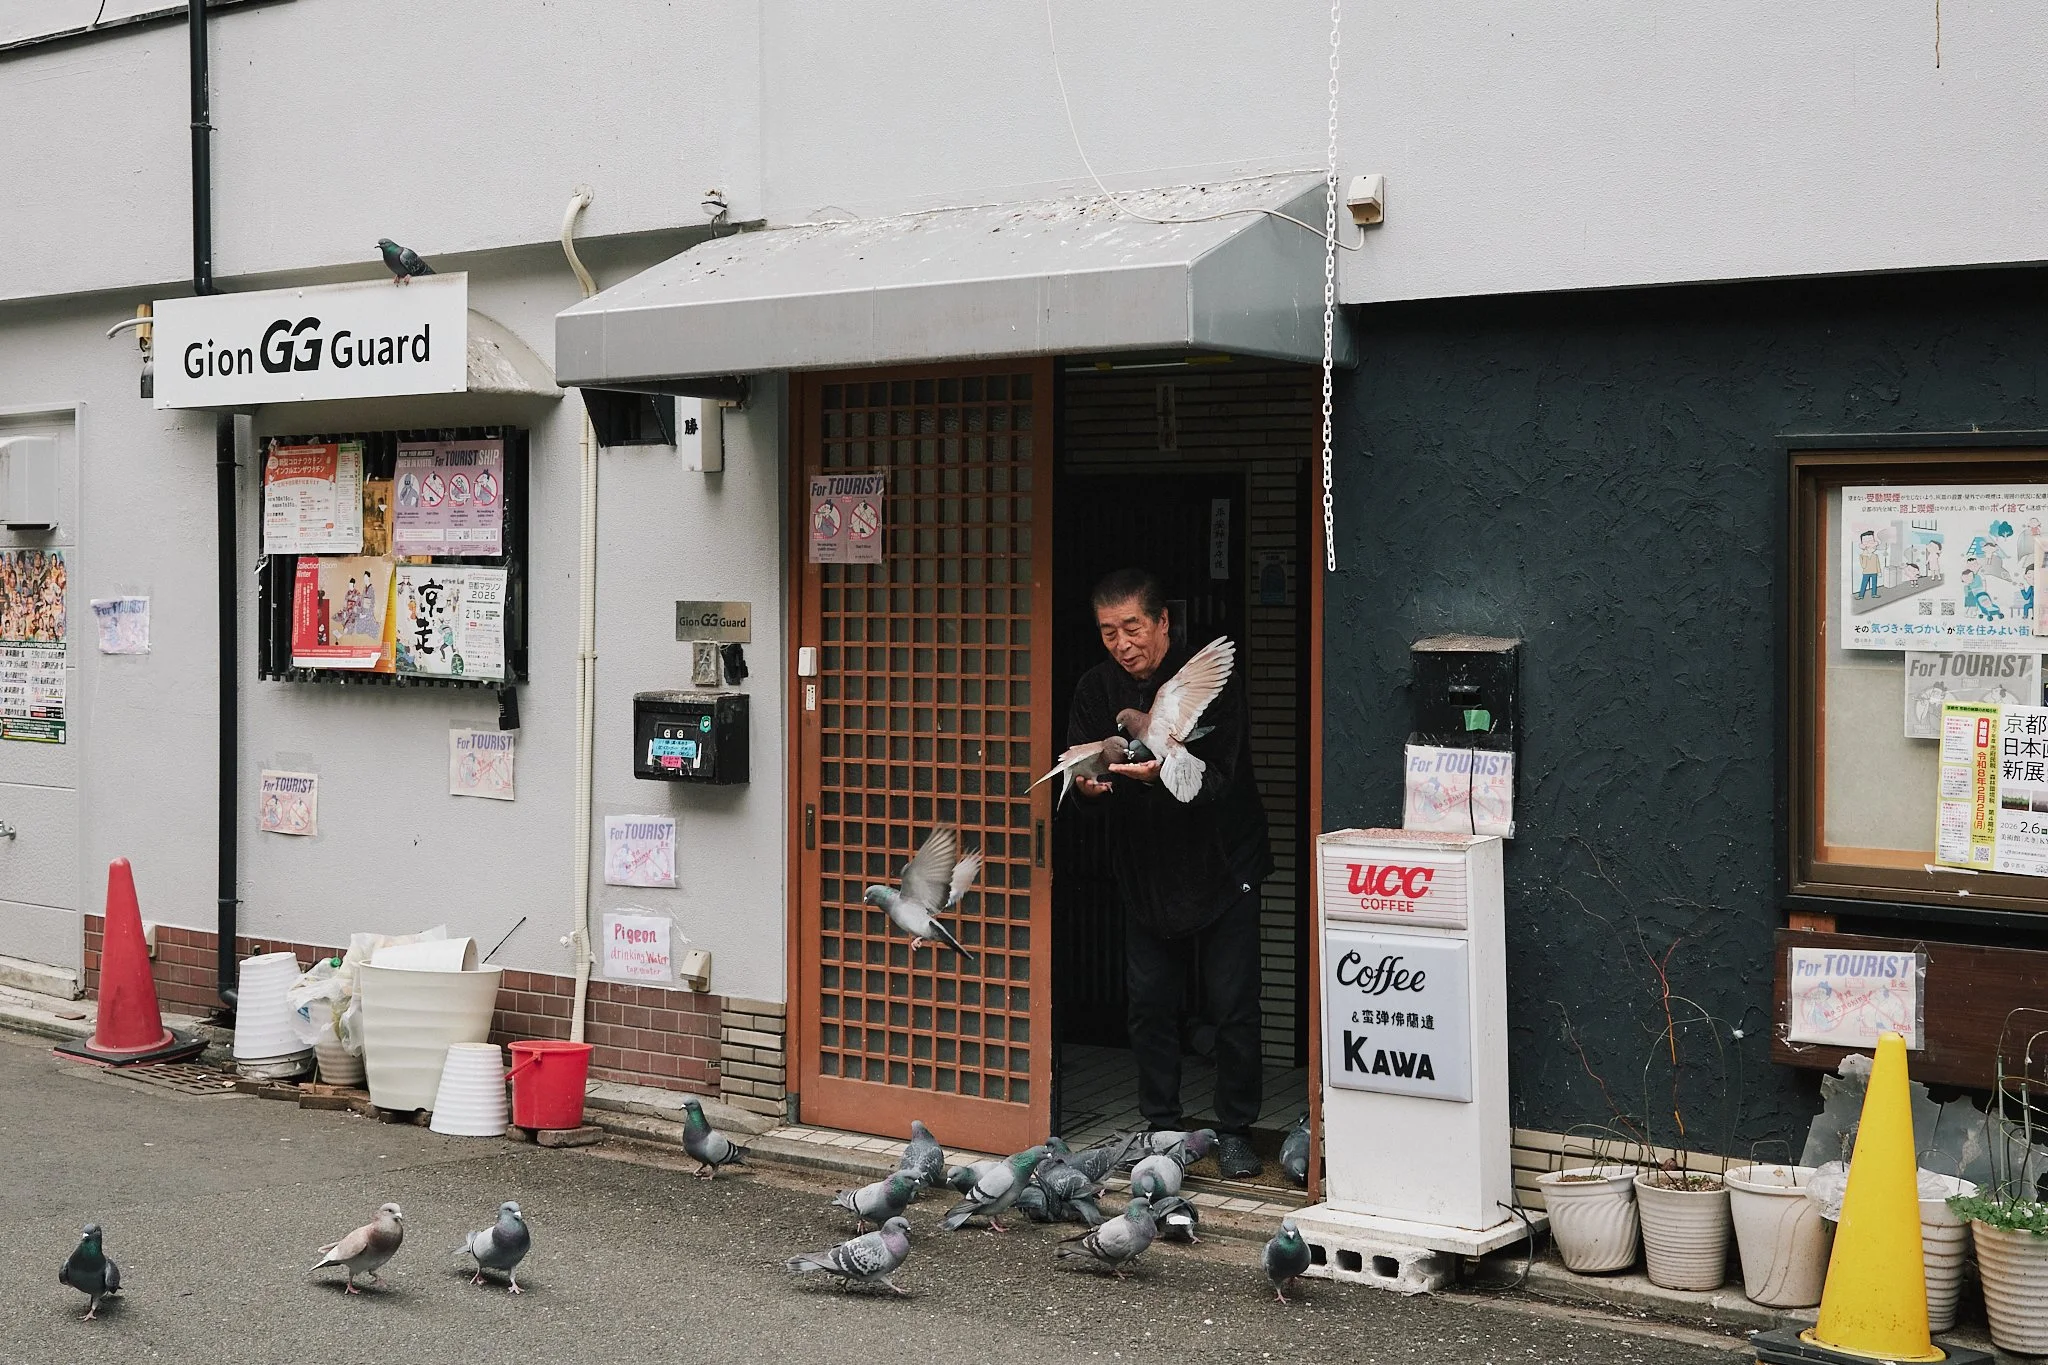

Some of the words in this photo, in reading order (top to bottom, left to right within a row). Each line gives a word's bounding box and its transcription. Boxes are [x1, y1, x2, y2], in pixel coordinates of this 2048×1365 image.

[184, 338, 252, 379] Gion
[260, 316, 322, 374] GG
[330, 324, 430, 369] Guard
[684, 418, 699, 435] 勝
[279, 457, 322, 466] 新型コロナワクチン
[434, 456, 445, 466] For
[446, 450, 478, 466] TOURIST
[478, 449, 500, 466] SHIP
[274, 466, 325, 475] インフルエンザワクチン
[812, 482, 827, 496] For
[828, 476, 884, 496] TOURIST
[468, 582, 501, 591] 京都マラソン
[472, 591, 496, 600] 2026
[96, 605, 111, 616] For
[112, 600, 146, 614] TOURIST
[679, 616, 700, 626] Gion
[700, 614, 718, 626] GG
[719, 617, 746, 628] Guard
[1910, 660, 1936, 677] For
[1938, 654, 2032, 678] TOURIST
[2004, 713, 2046, 735] 京都
[456, 737, 470, 749] For
[470, 734, 513, 750] TOURIST
[1410, 756, 1432, 773] For
[1435, 752, 1511, 776] TOURIST
[2003, 760, 2044, 782] 新展
[263, 780, 275, 791] For
[275, 777, 314, 793] TOURIST
[610, 828, 624, 840] For
[624, 823, 673, 840] TOURIST
[2000, 822, 2018, 830] 2026
[2020, 822, 2040, 834] 2.6
[1346, 864, 1434, 898] UCC
[1361, 898, 1414, 912] COFFEE
[614, 923, 656, 944] Pigeon
[610, 946, 645, 963] drinking
[1336, 950, 1426, 996] Coffee
[1796, 959, 1821, 976] For
[1824, 954, 1914, 978] TOURIST
[1352, 1012, 1359, 1023] &
[1344, 1030, 1435, 1080] KAWA
